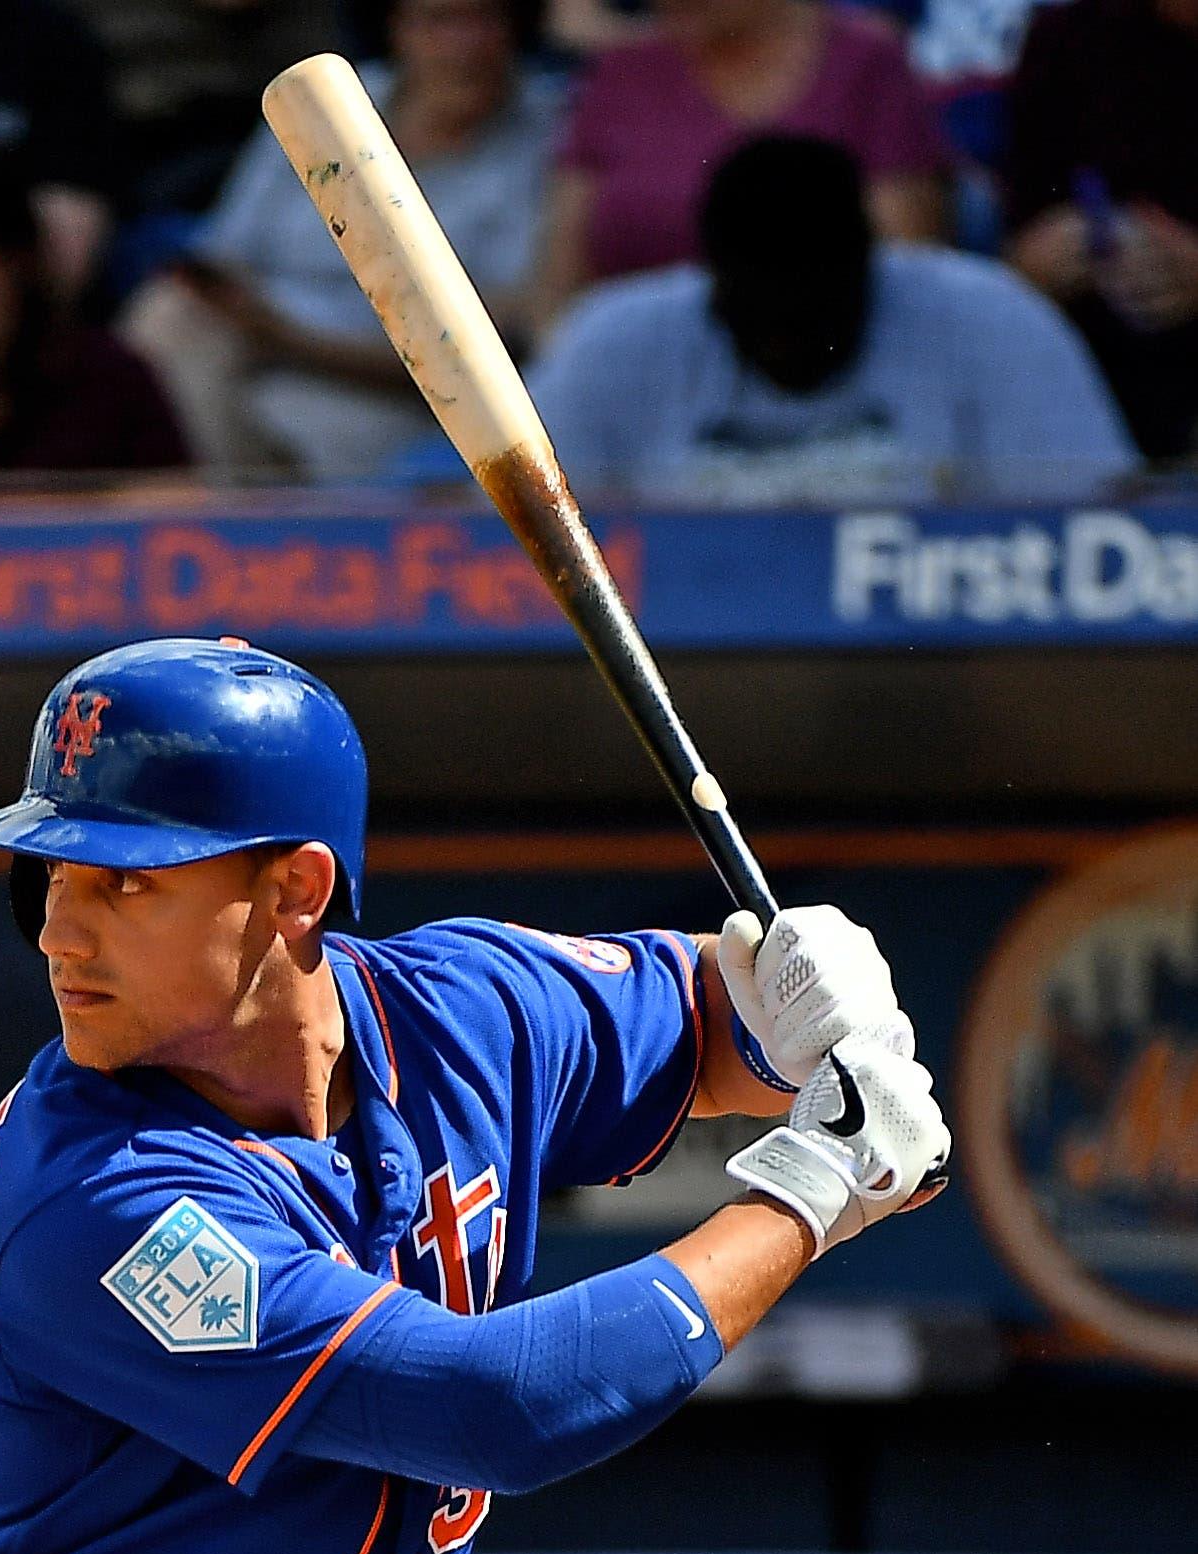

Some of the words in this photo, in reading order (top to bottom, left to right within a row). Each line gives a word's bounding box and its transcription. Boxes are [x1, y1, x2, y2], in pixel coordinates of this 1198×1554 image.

[140, 523, 384, 631] Data
[832, 511, 1056, 625] First
[145, 1243, 229, 1320] FLA
[149, 1212, 199, 1262] 2019
